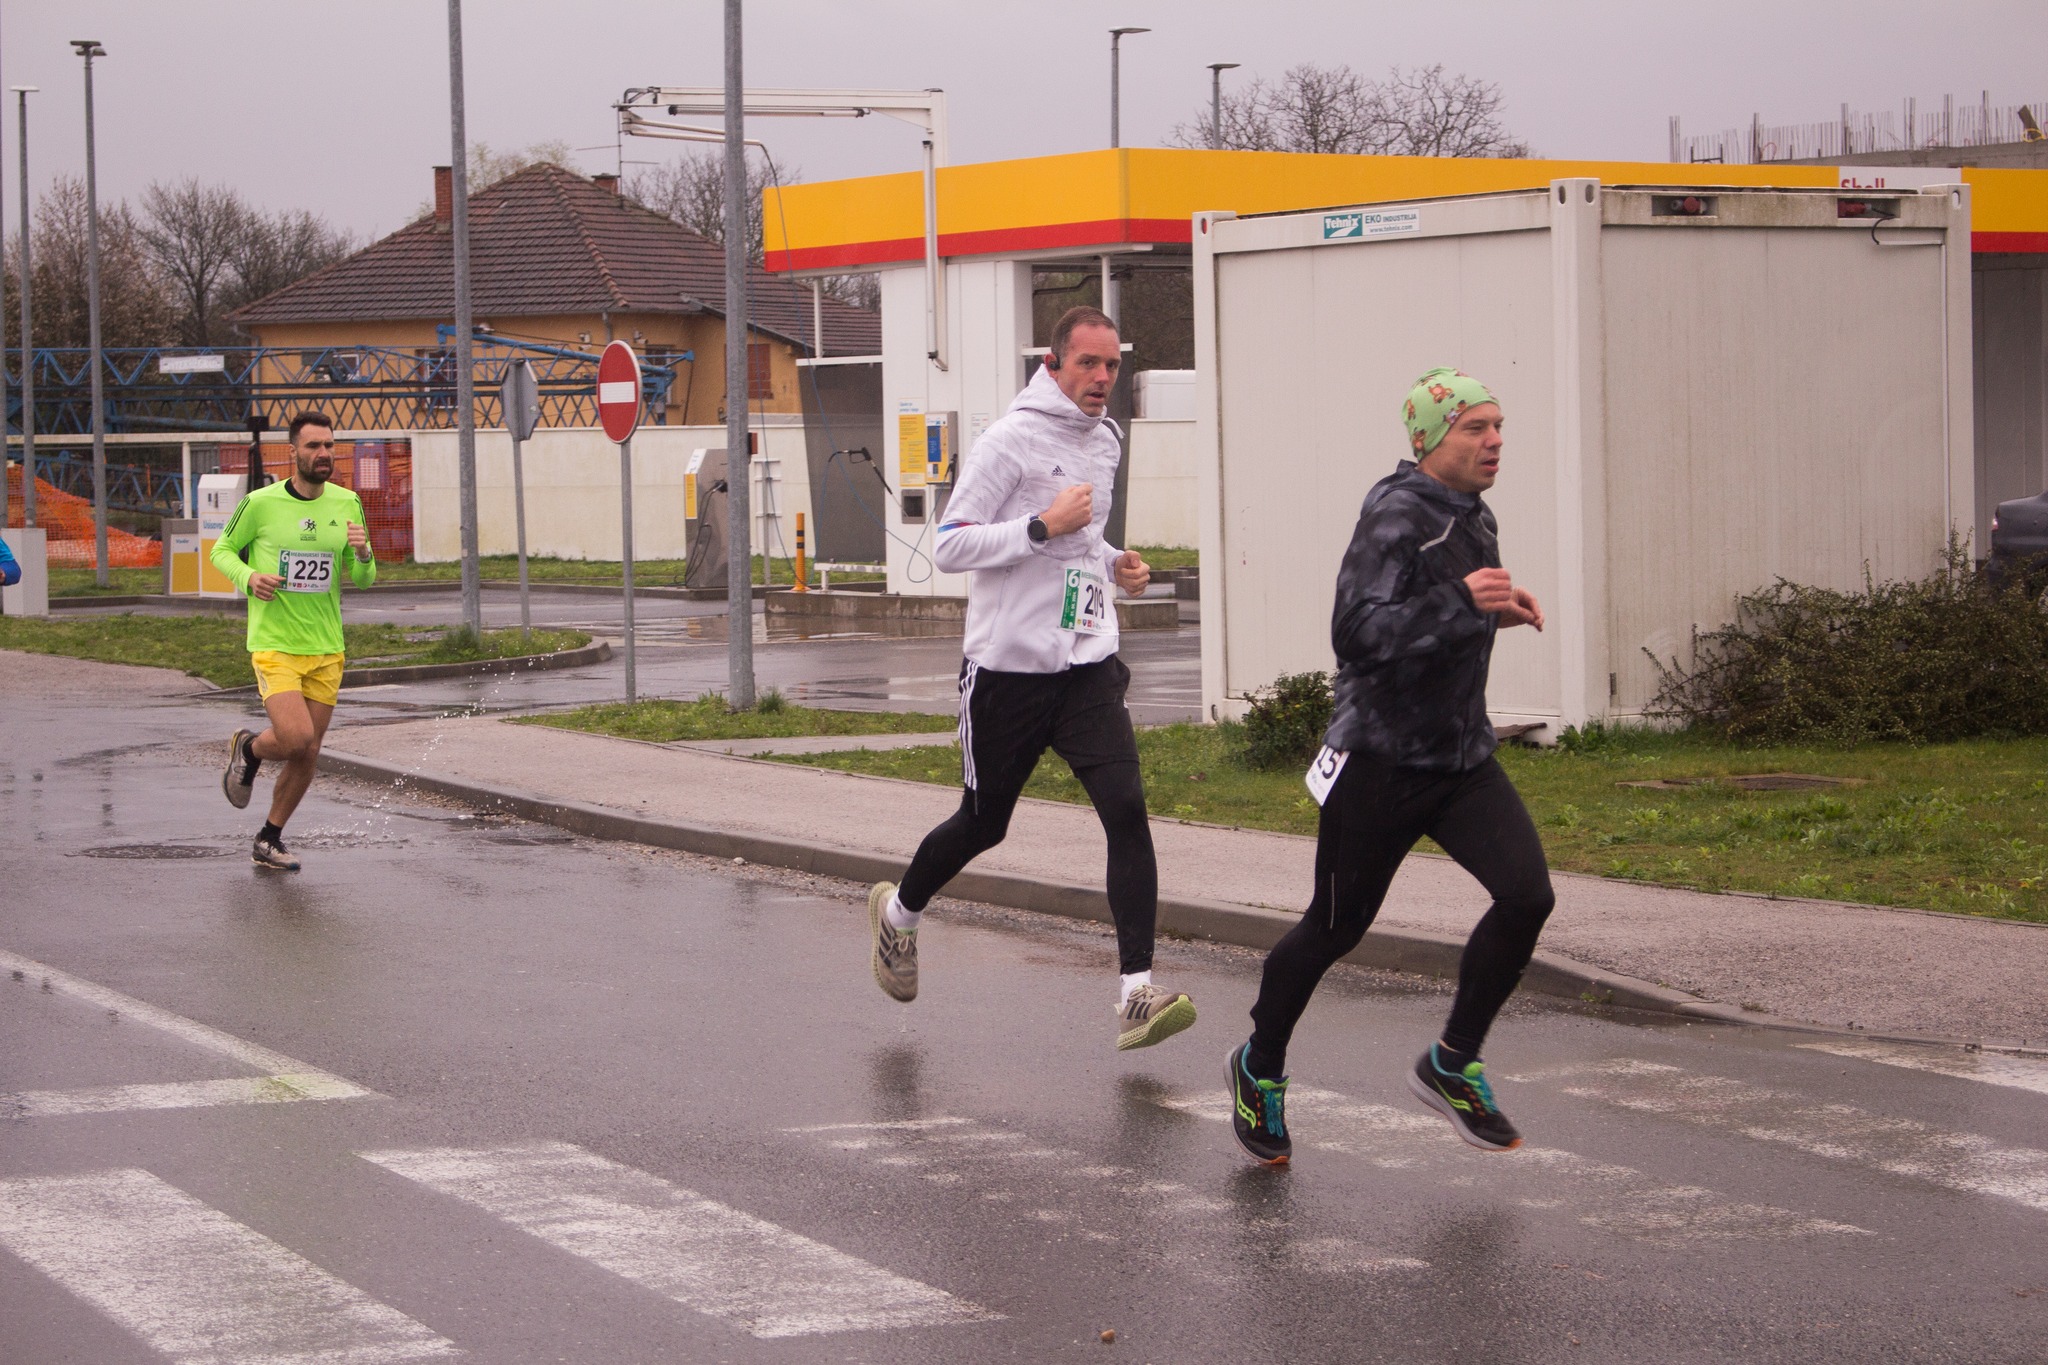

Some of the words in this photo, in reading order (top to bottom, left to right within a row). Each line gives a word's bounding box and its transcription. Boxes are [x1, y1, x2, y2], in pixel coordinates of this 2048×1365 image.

[1325, 214, 1359, 229] Tehnix
[1365, 214, 1381, 224] EKO
[1382, 213, 1417, 223] INDUSTRIJA
[281, 551, 289, 562] 6
[294, 560, 330, 581] 225
[1067, 570, 1080, 588] 6
[1084, 584, 1104, 619] 209
